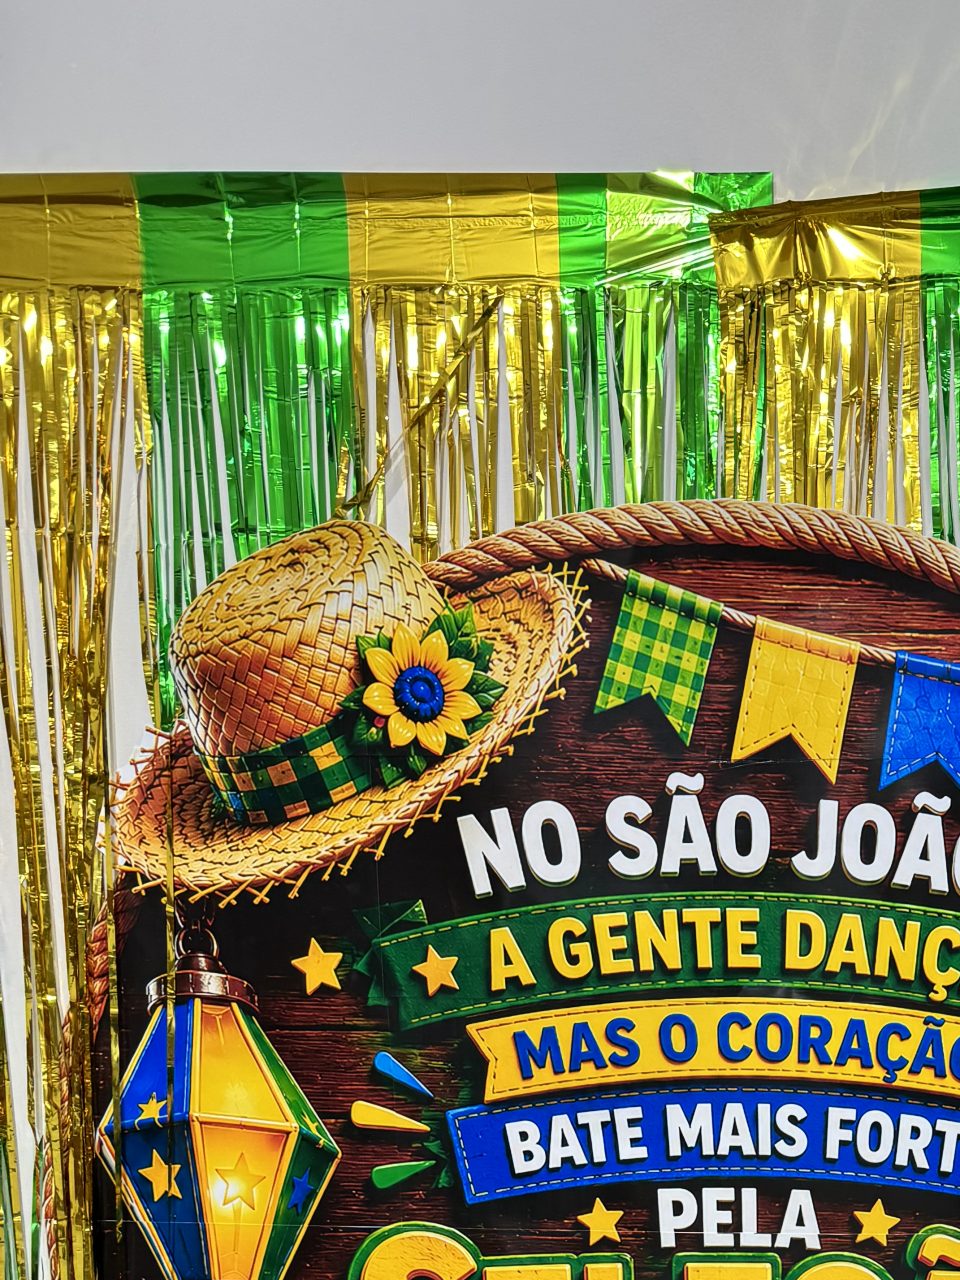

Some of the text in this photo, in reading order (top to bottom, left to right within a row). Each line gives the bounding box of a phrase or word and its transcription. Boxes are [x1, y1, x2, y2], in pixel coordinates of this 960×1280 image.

[457, 800, 581, 898] NO
[605, 771, 771, 878] SÃO
[489, 926, 536, 992] A
[547, 907, 763, 979] GENTE
[511, 1016, 640, 1080] MAS
[662, 1011, 699, 1063] O
[505, 1107, 650, 1176] BATE
[668, 1102, 808, 1158] MAIS
[656, 1187, 822, 1250] PELA
